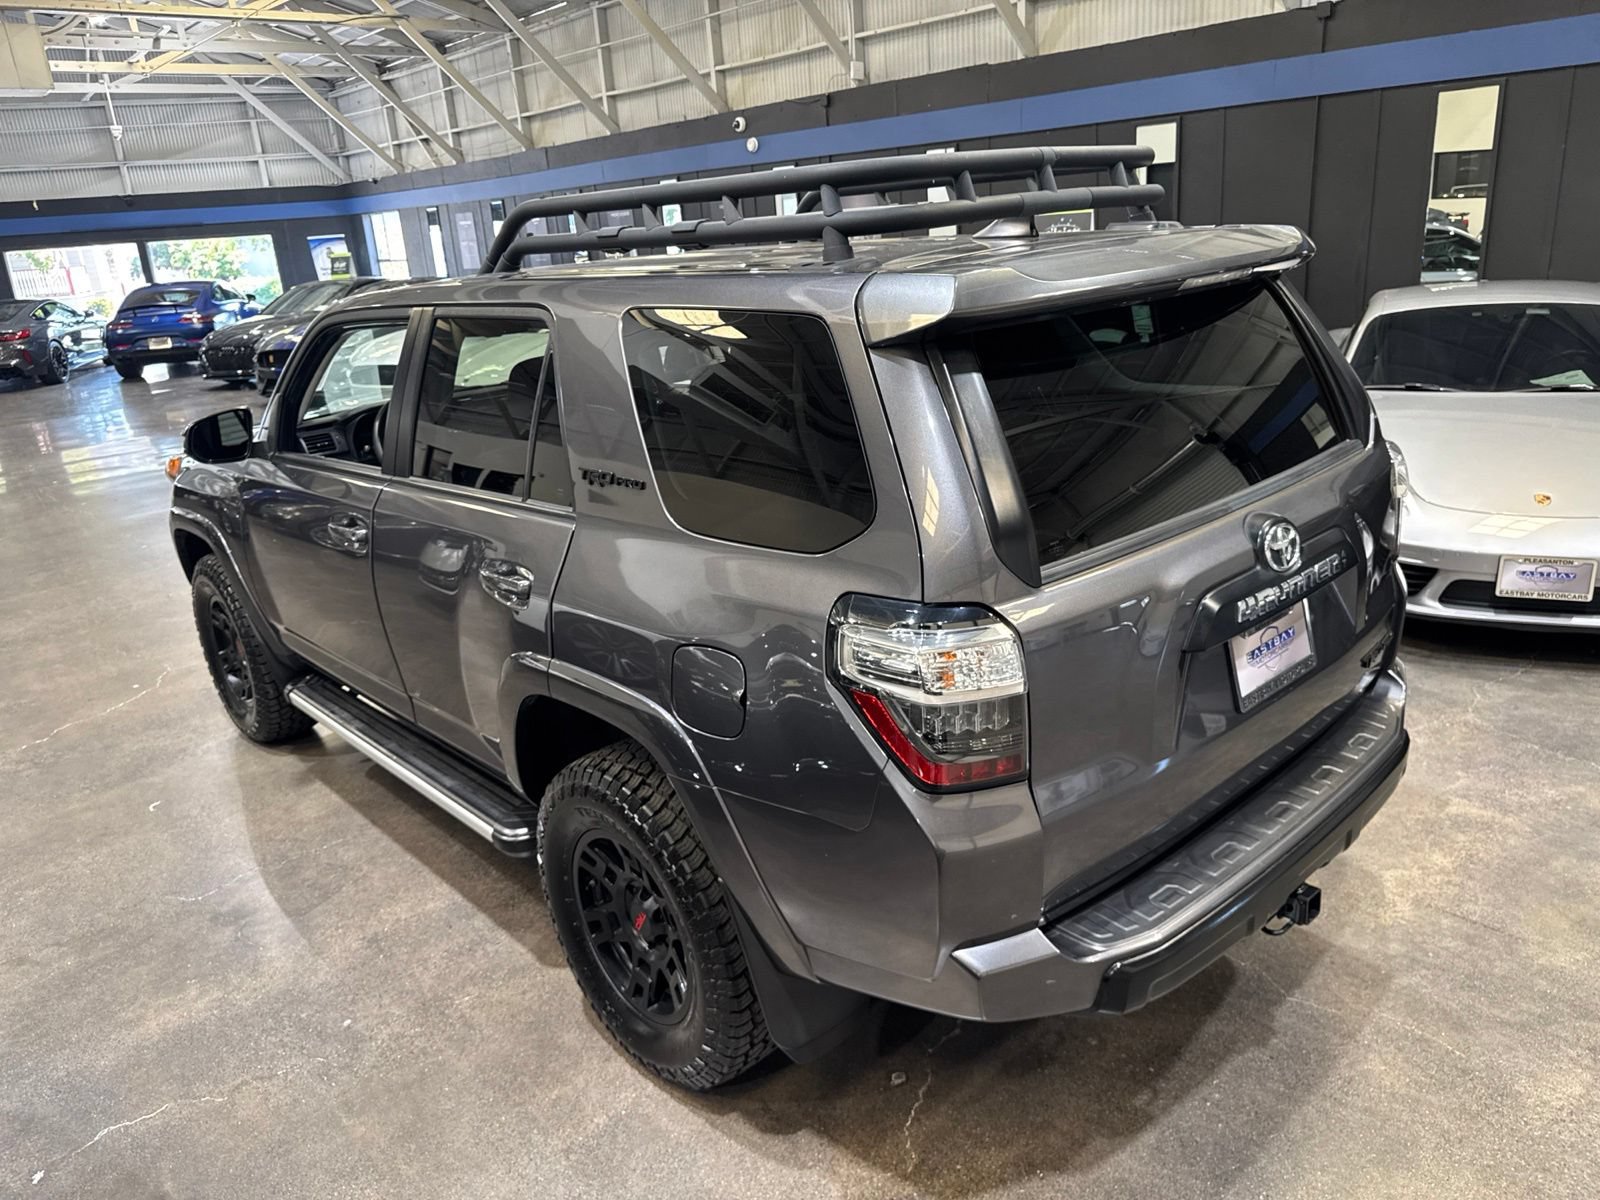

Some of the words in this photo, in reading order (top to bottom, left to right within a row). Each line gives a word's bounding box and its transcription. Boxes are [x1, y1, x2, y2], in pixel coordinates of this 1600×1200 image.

[1523, 557, 1574, 566] PLEASANTON
[1237, 553, 1341, 623] 4RUNNER
[1499, 590, 1535, 598] EASTBAY
[1537, 592, 1589, 601] MOTORCARS
[1246, 626, 1295, 664] EASTBAY
